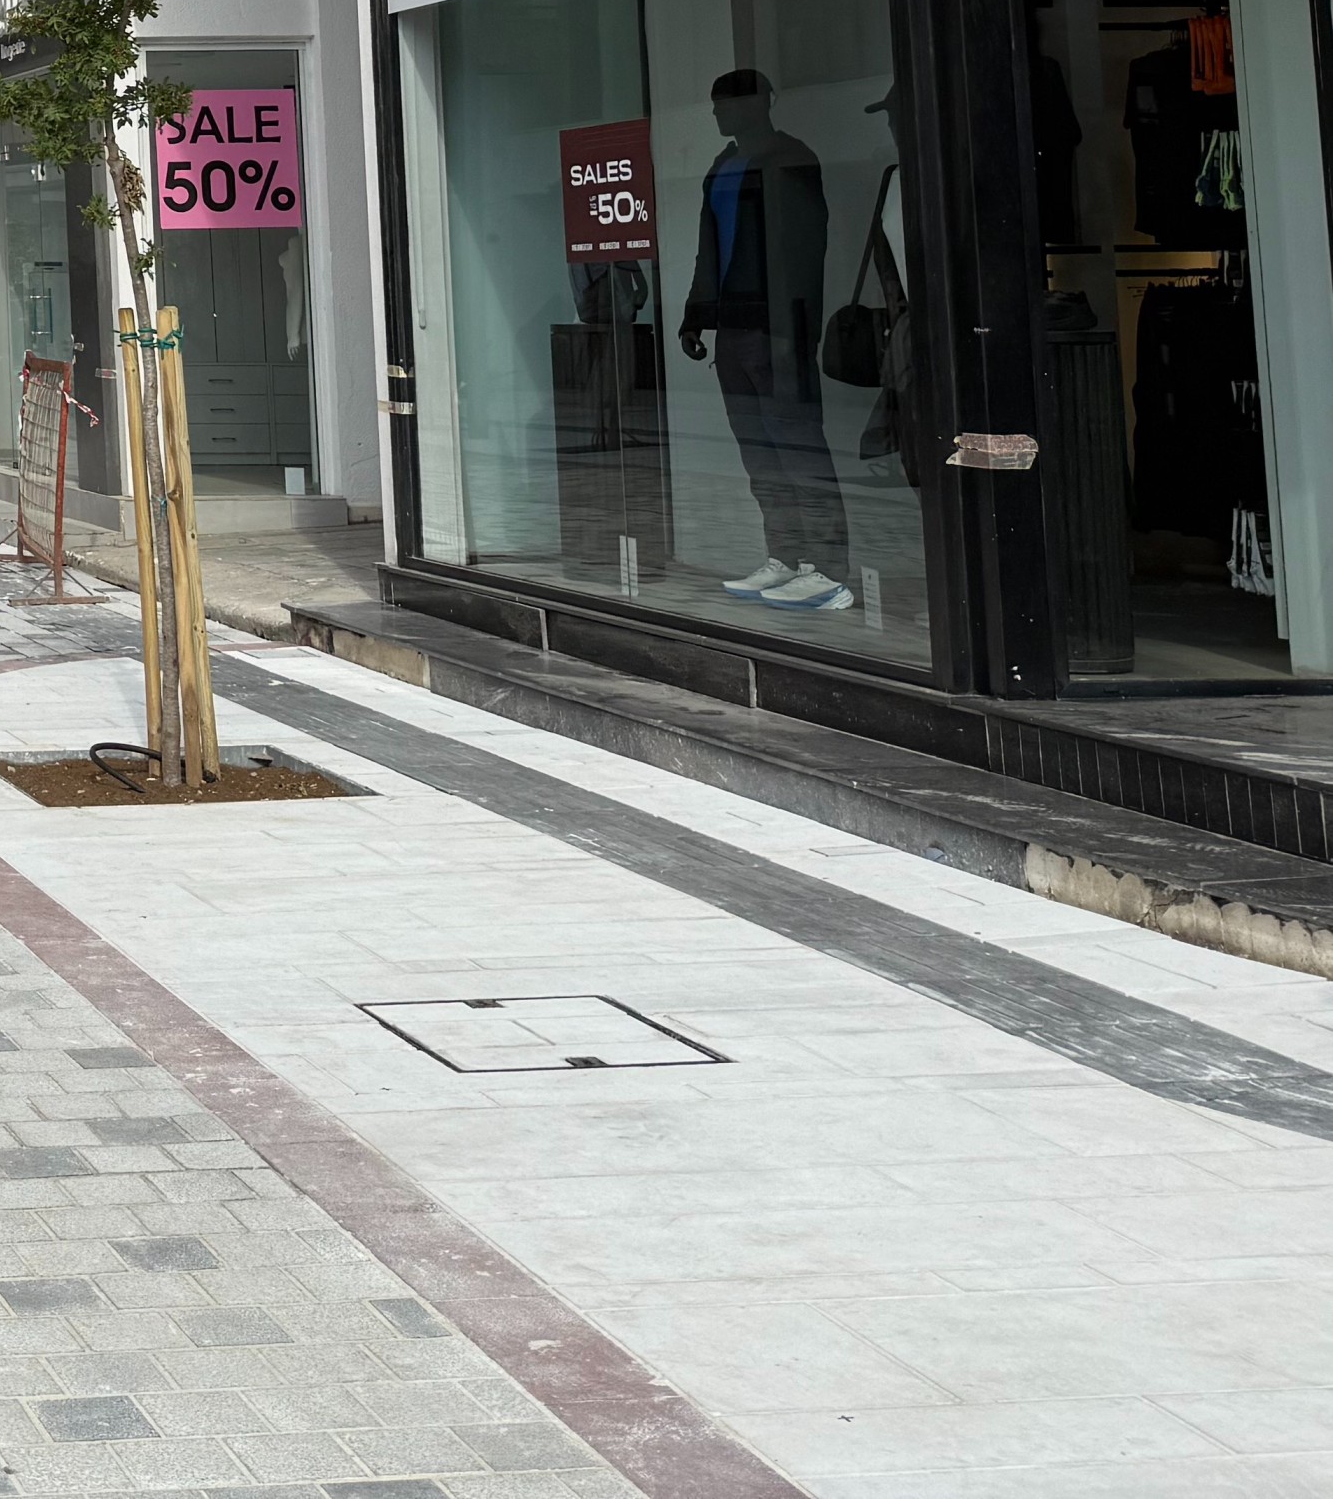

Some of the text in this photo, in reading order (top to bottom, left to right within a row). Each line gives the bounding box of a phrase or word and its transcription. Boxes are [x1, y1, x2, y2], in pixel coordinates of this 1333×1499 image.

[164, 105, 281, 144] SALE
[163, 159, 296, 213] 50%
[570, 159, 633, 187] SALES
